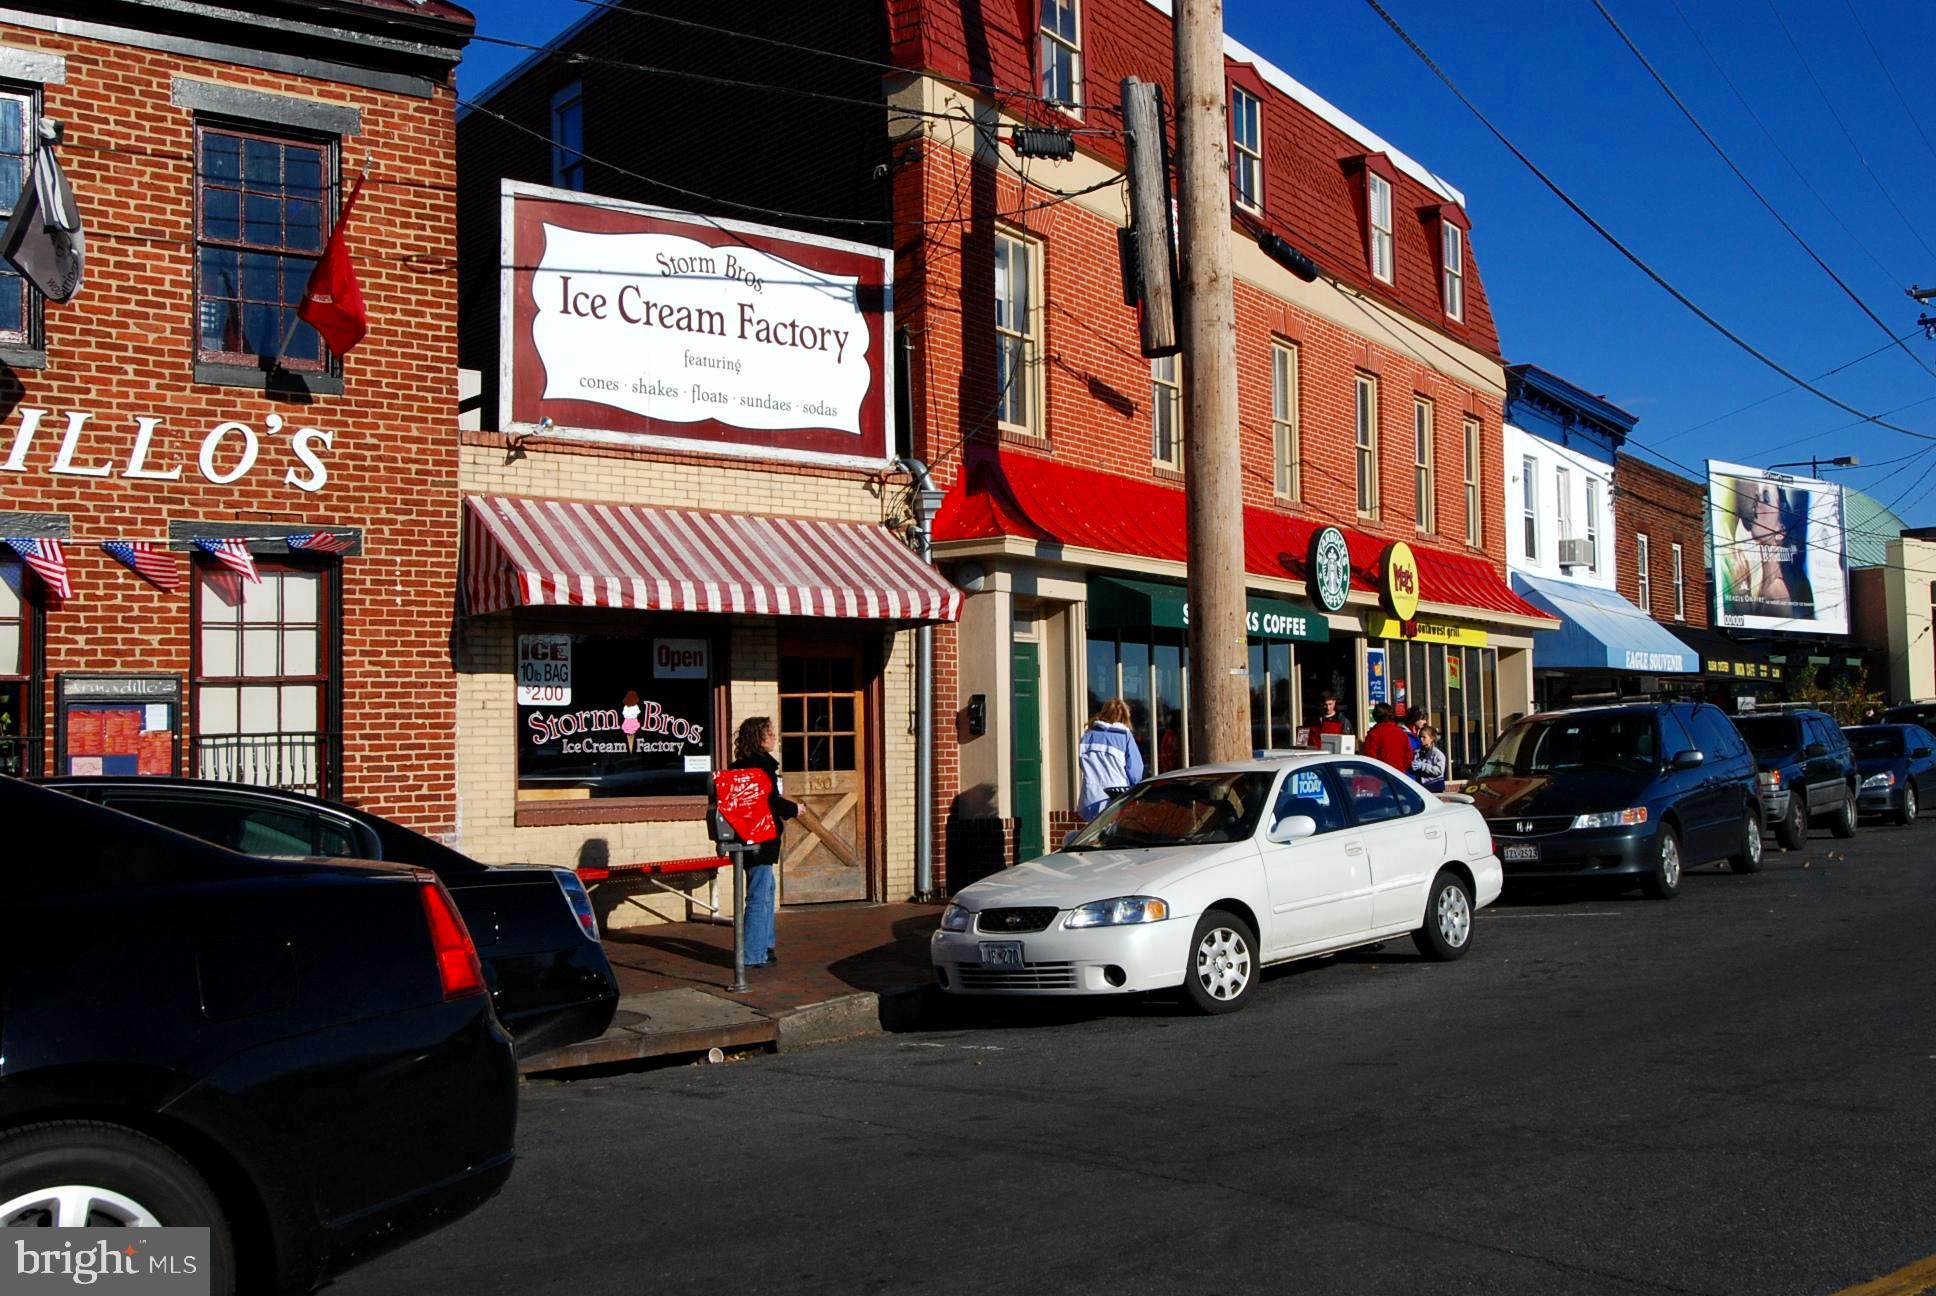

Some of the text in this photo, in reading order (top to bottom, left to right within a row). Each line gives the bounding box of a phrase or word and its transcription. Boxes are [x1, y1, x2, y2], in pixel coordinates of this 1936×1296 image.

[656, 252, 764, 294] Storm Bros.
[559, 275, 849, 364] Ice Cream Factory
[684, 349, 742, 374] featuring
[579, 376, 838, 417] cones shakes floats sundaes sodas
[1321, 584, 1345, 606] COFFEE
[1263, 613, 1307, 636] COFFEE
[521, 640, 569, 661] ICE
[657, 644, 704, 672] Open
[544, 663, 569, 682] BAG
[1625, 651, 1683, 673] EAGLE SOUVENIR
[525, 684, 564, 701] $2.00
[528, 700, 703, 747] Storm Bros.
[562, 738, 685, 756] Ice Cream Factory
[1299, 780, 1323, 794] TODAY
